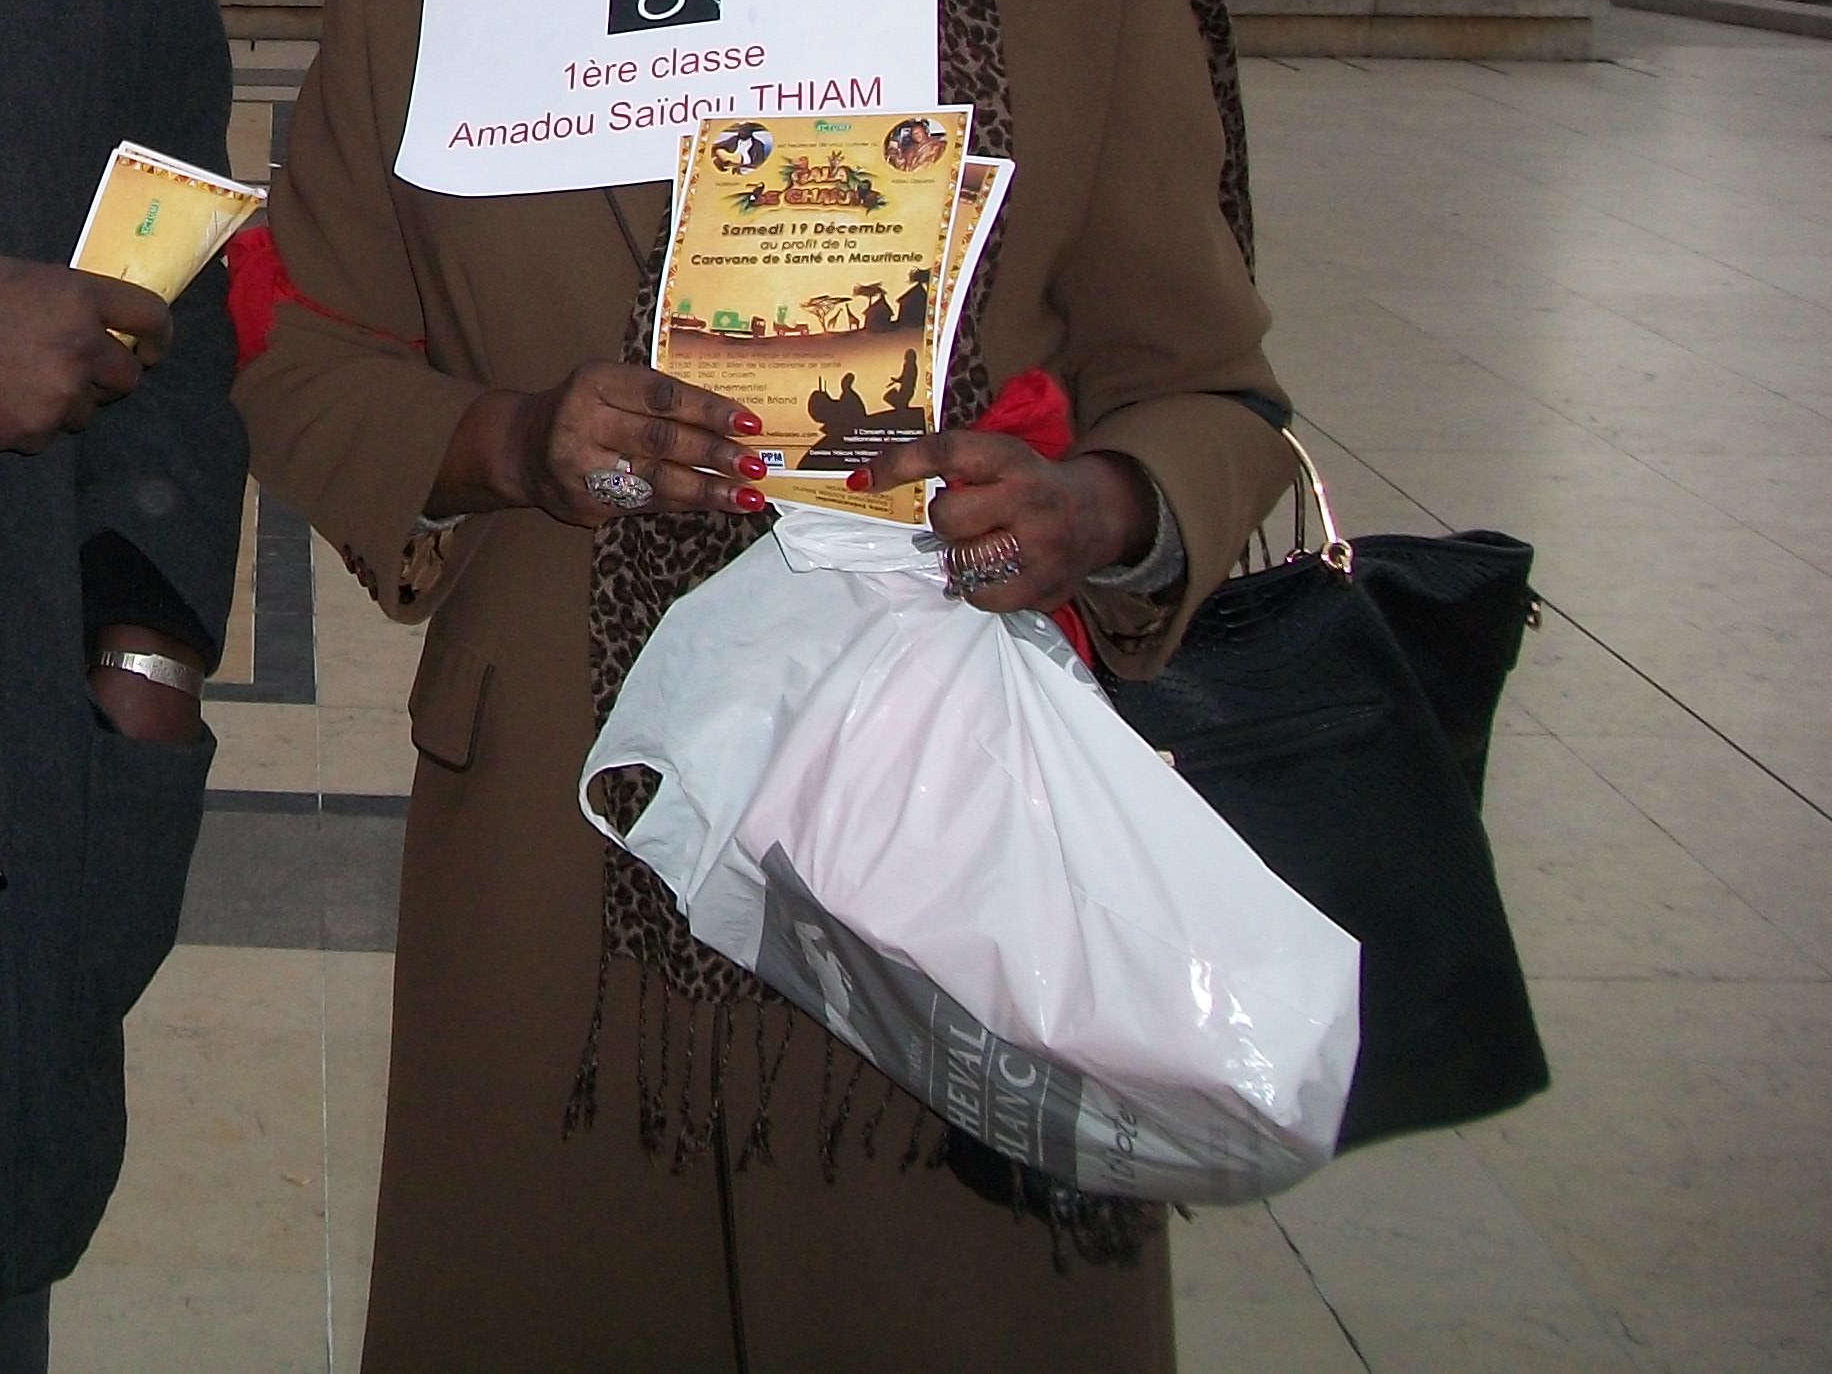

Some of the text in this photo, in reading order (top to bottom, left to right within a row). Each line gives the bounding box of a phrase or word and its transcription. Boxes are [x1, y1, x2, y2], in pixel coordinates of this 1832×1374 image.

[564, 44, 766, 90] 1ère classe
[448, 112, 594, 148] Amadou
[750, 76, 882, 112] THIAM
[721, 220, 904, 236] Samedi 19 Décembre
[691, 252, 924, 265] Caravane de Santé en Mauritanie
[760, 239, 857, 252] au profit de la
[947, 1024, 988, 1138] HEVAL
